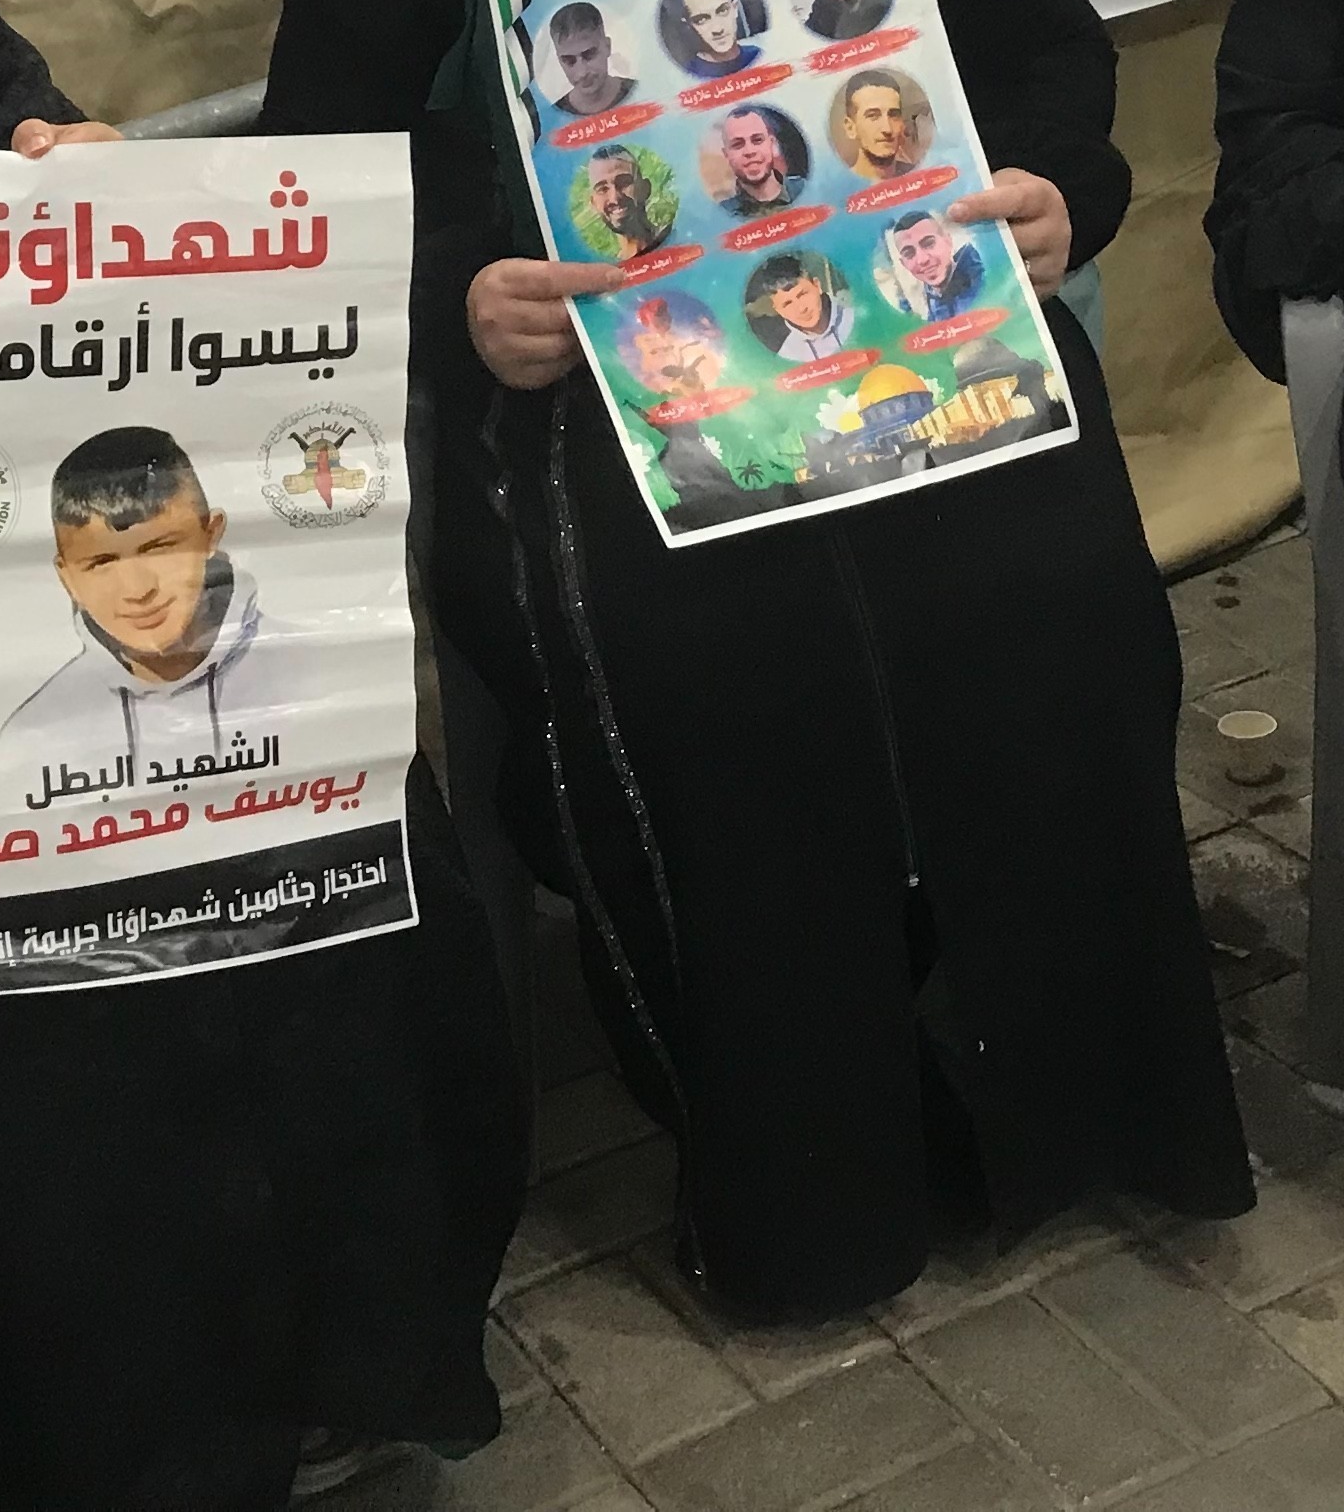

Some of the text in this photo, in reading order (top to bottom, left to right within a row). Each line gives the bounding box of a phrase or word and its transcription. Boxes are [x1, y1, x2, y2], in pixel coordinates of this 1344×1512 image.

[171, 306, 358, 386] ليسوا
[26, 730, 280, 810] الشهيد البطل
[204, 770, 367, 821] يوسف
[56, 800, 189, 855] محمد
[228, 871, 316, 921] جثامين
[322, 856, 386, 905] احتجاز
[107, 888, 221, 941] شهداؤنا
[22, 921, 99, 963] جريمة
